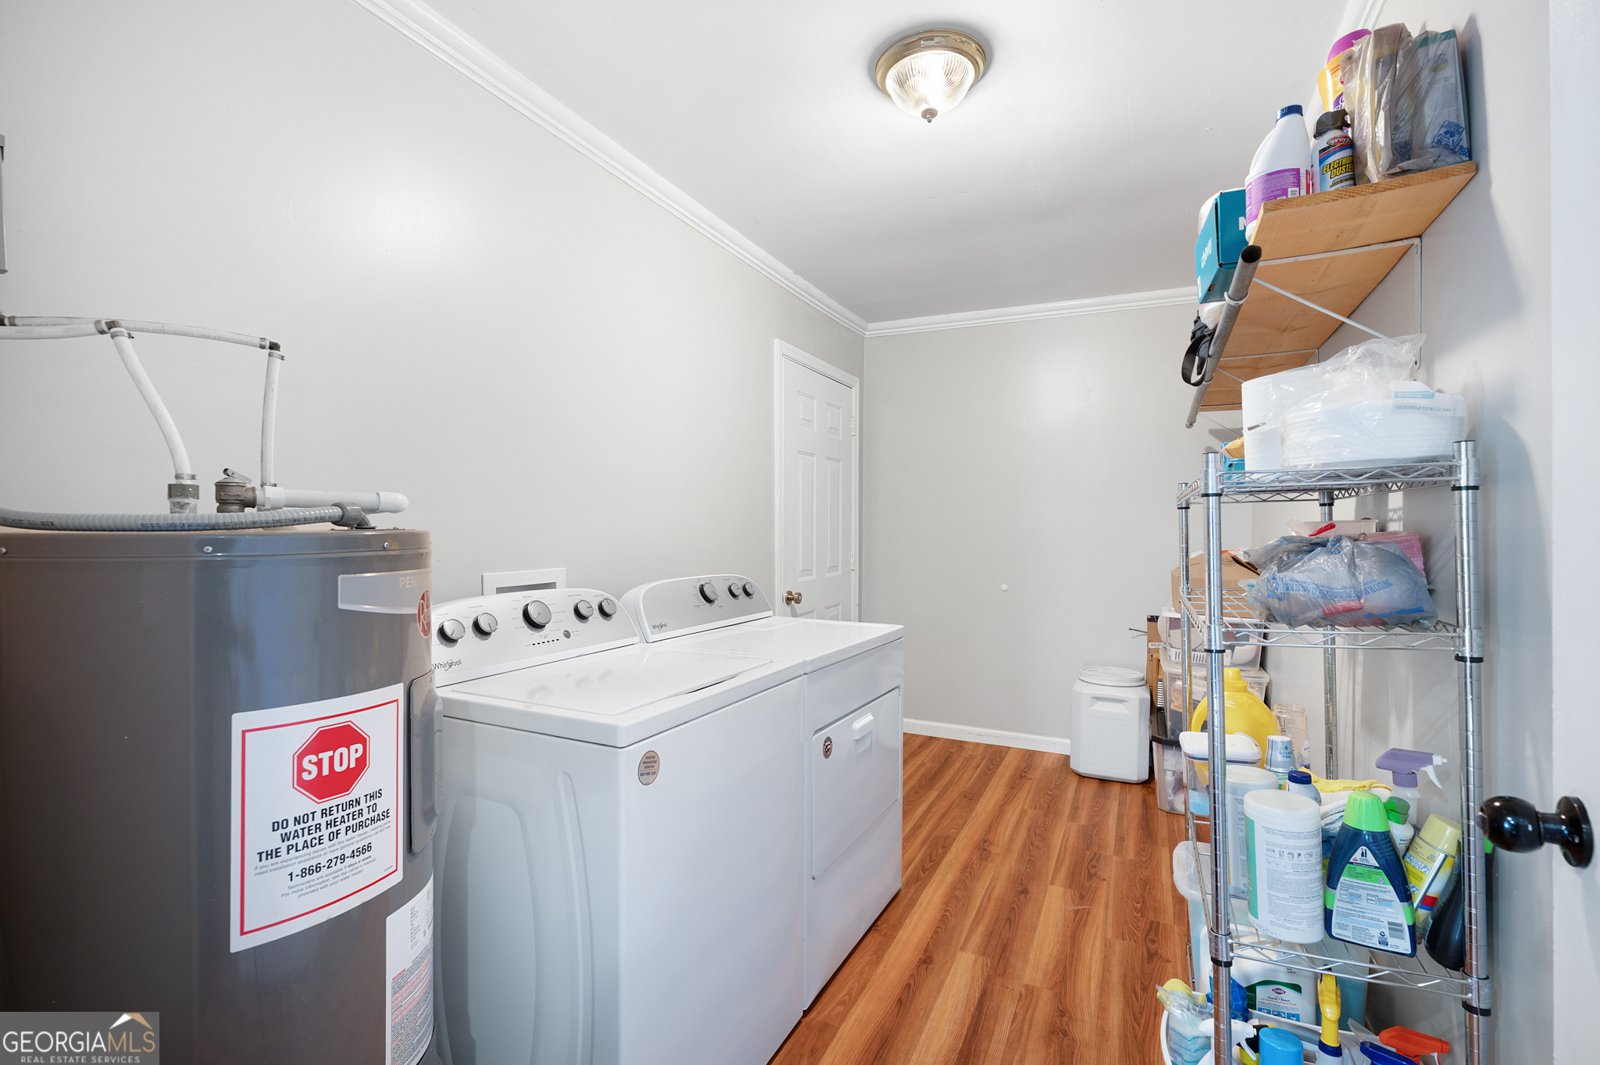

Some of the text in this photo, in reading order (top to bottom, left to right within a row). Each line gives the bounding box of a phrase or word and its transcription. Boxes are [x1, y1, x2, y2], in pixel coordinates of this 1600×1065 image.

[1330, 164, 1354, 178] DUSTE
[432, 659, 462, 671] Whirlpool
[301, 743, 364, 781] STOP
[272, 788, 383, 832] DO NOT RETURN THIS
[280, 802, 378, 843] WATER HEATER TO
[256, 808, 391, 862] THE PLACE OF PURCHASE
[287, 842, 373, 882] 1-866-279-4566
